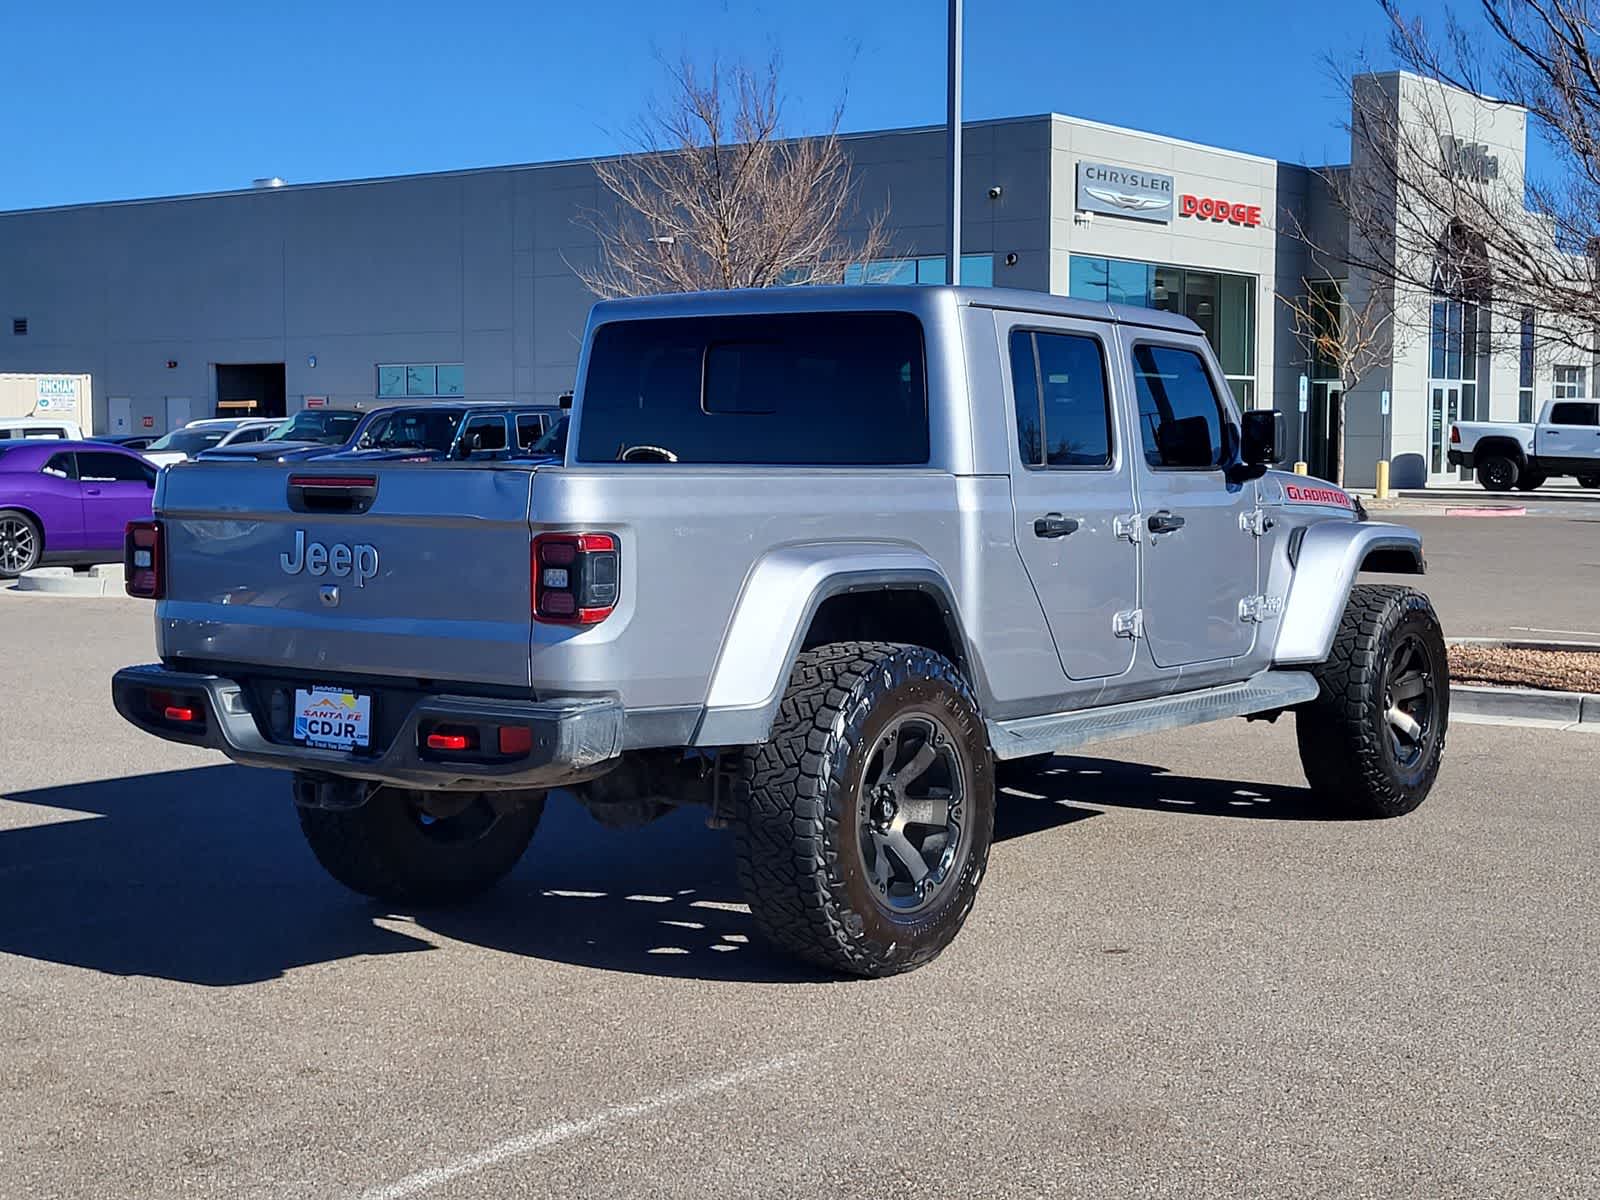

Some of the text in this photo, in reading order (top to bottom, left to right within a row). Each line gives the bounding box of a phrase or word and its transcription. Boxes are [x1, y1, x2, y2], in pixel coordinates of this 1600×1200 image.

[1085, 167, 1171, 192] CHRYSLER
[1179, 194, 1262, 226] DODGE
[1286, 486, 1351, 506] GLADIATOR
[280, 530, 379, 588] Jeep
[303, 710, 362, 721] SANTA FE
